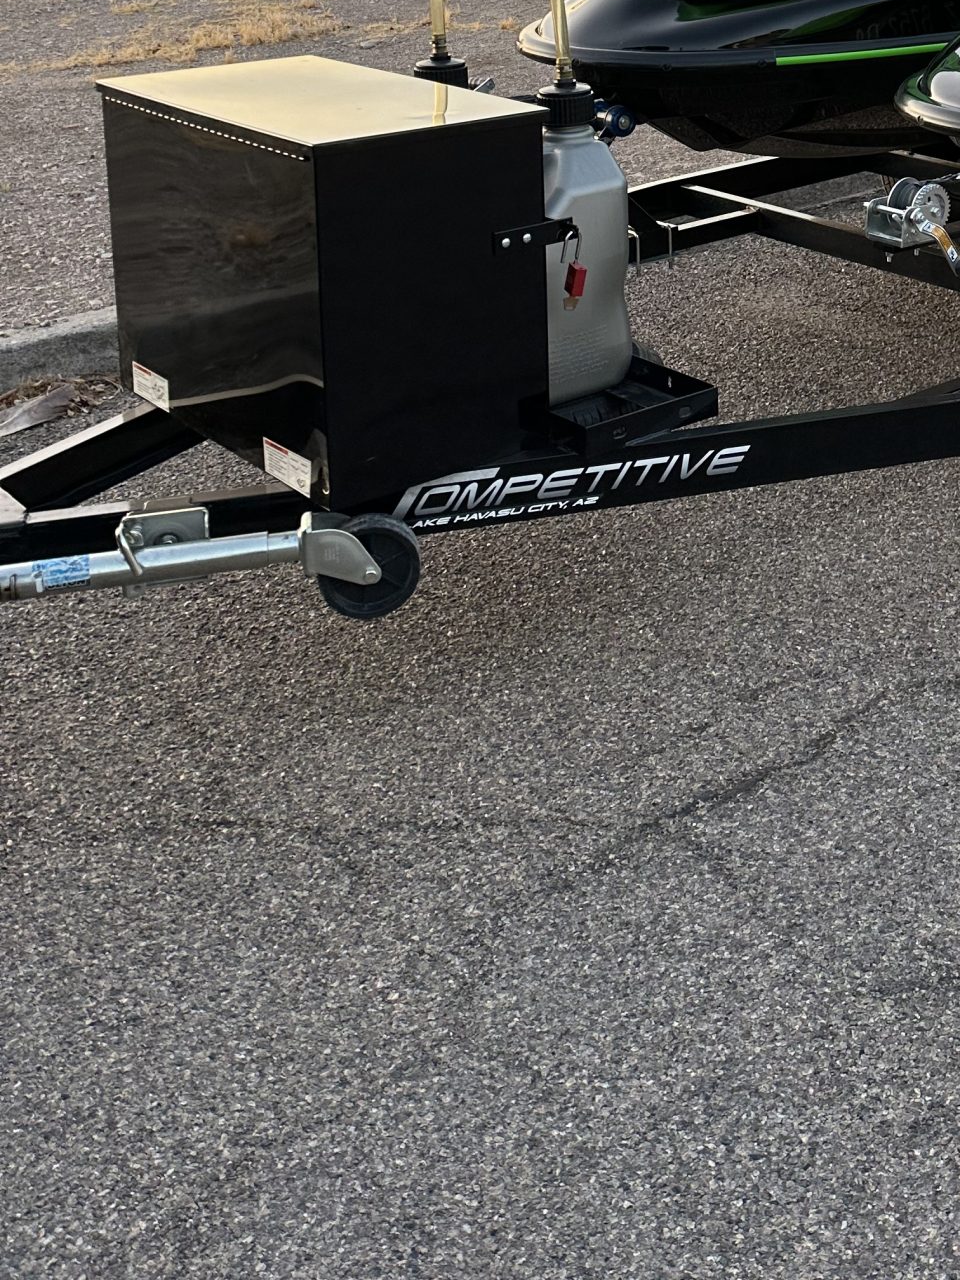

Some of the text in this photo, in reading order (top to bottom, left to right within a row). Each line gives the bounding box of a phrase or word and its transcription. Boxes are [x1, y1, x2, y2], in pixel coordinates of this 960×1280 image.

[391, 445, 751, 520] COMPETITIVE
[408, 496, 599, 529] AKE HAVASU CITY, AZ
